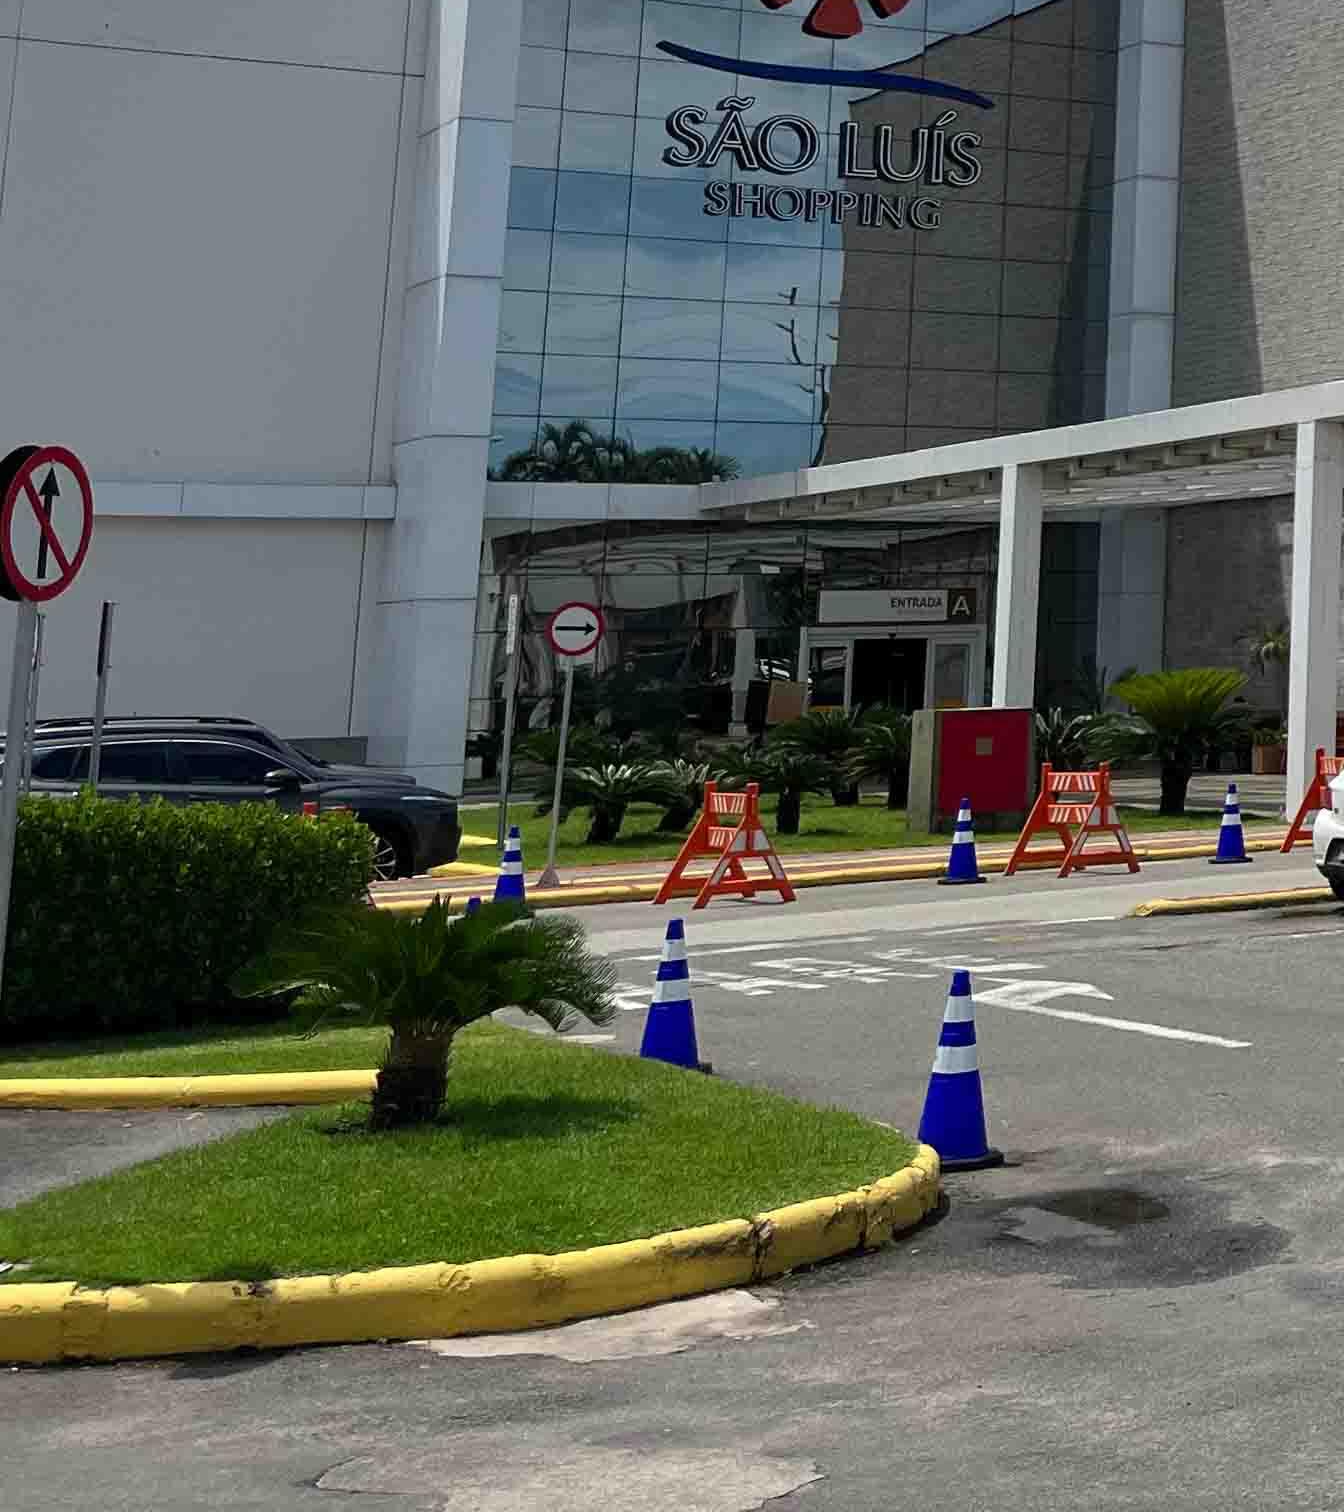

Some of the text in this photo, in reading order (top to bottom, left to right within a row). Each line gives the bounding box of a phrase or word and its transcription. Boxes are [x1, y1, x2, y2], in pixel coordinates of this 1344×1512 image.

[663, 96, 983, 187] SÃO LUÍS
[703, 178, 943, 230] SHOPPING
[890, 595, 971, 616] ENTRADA A
